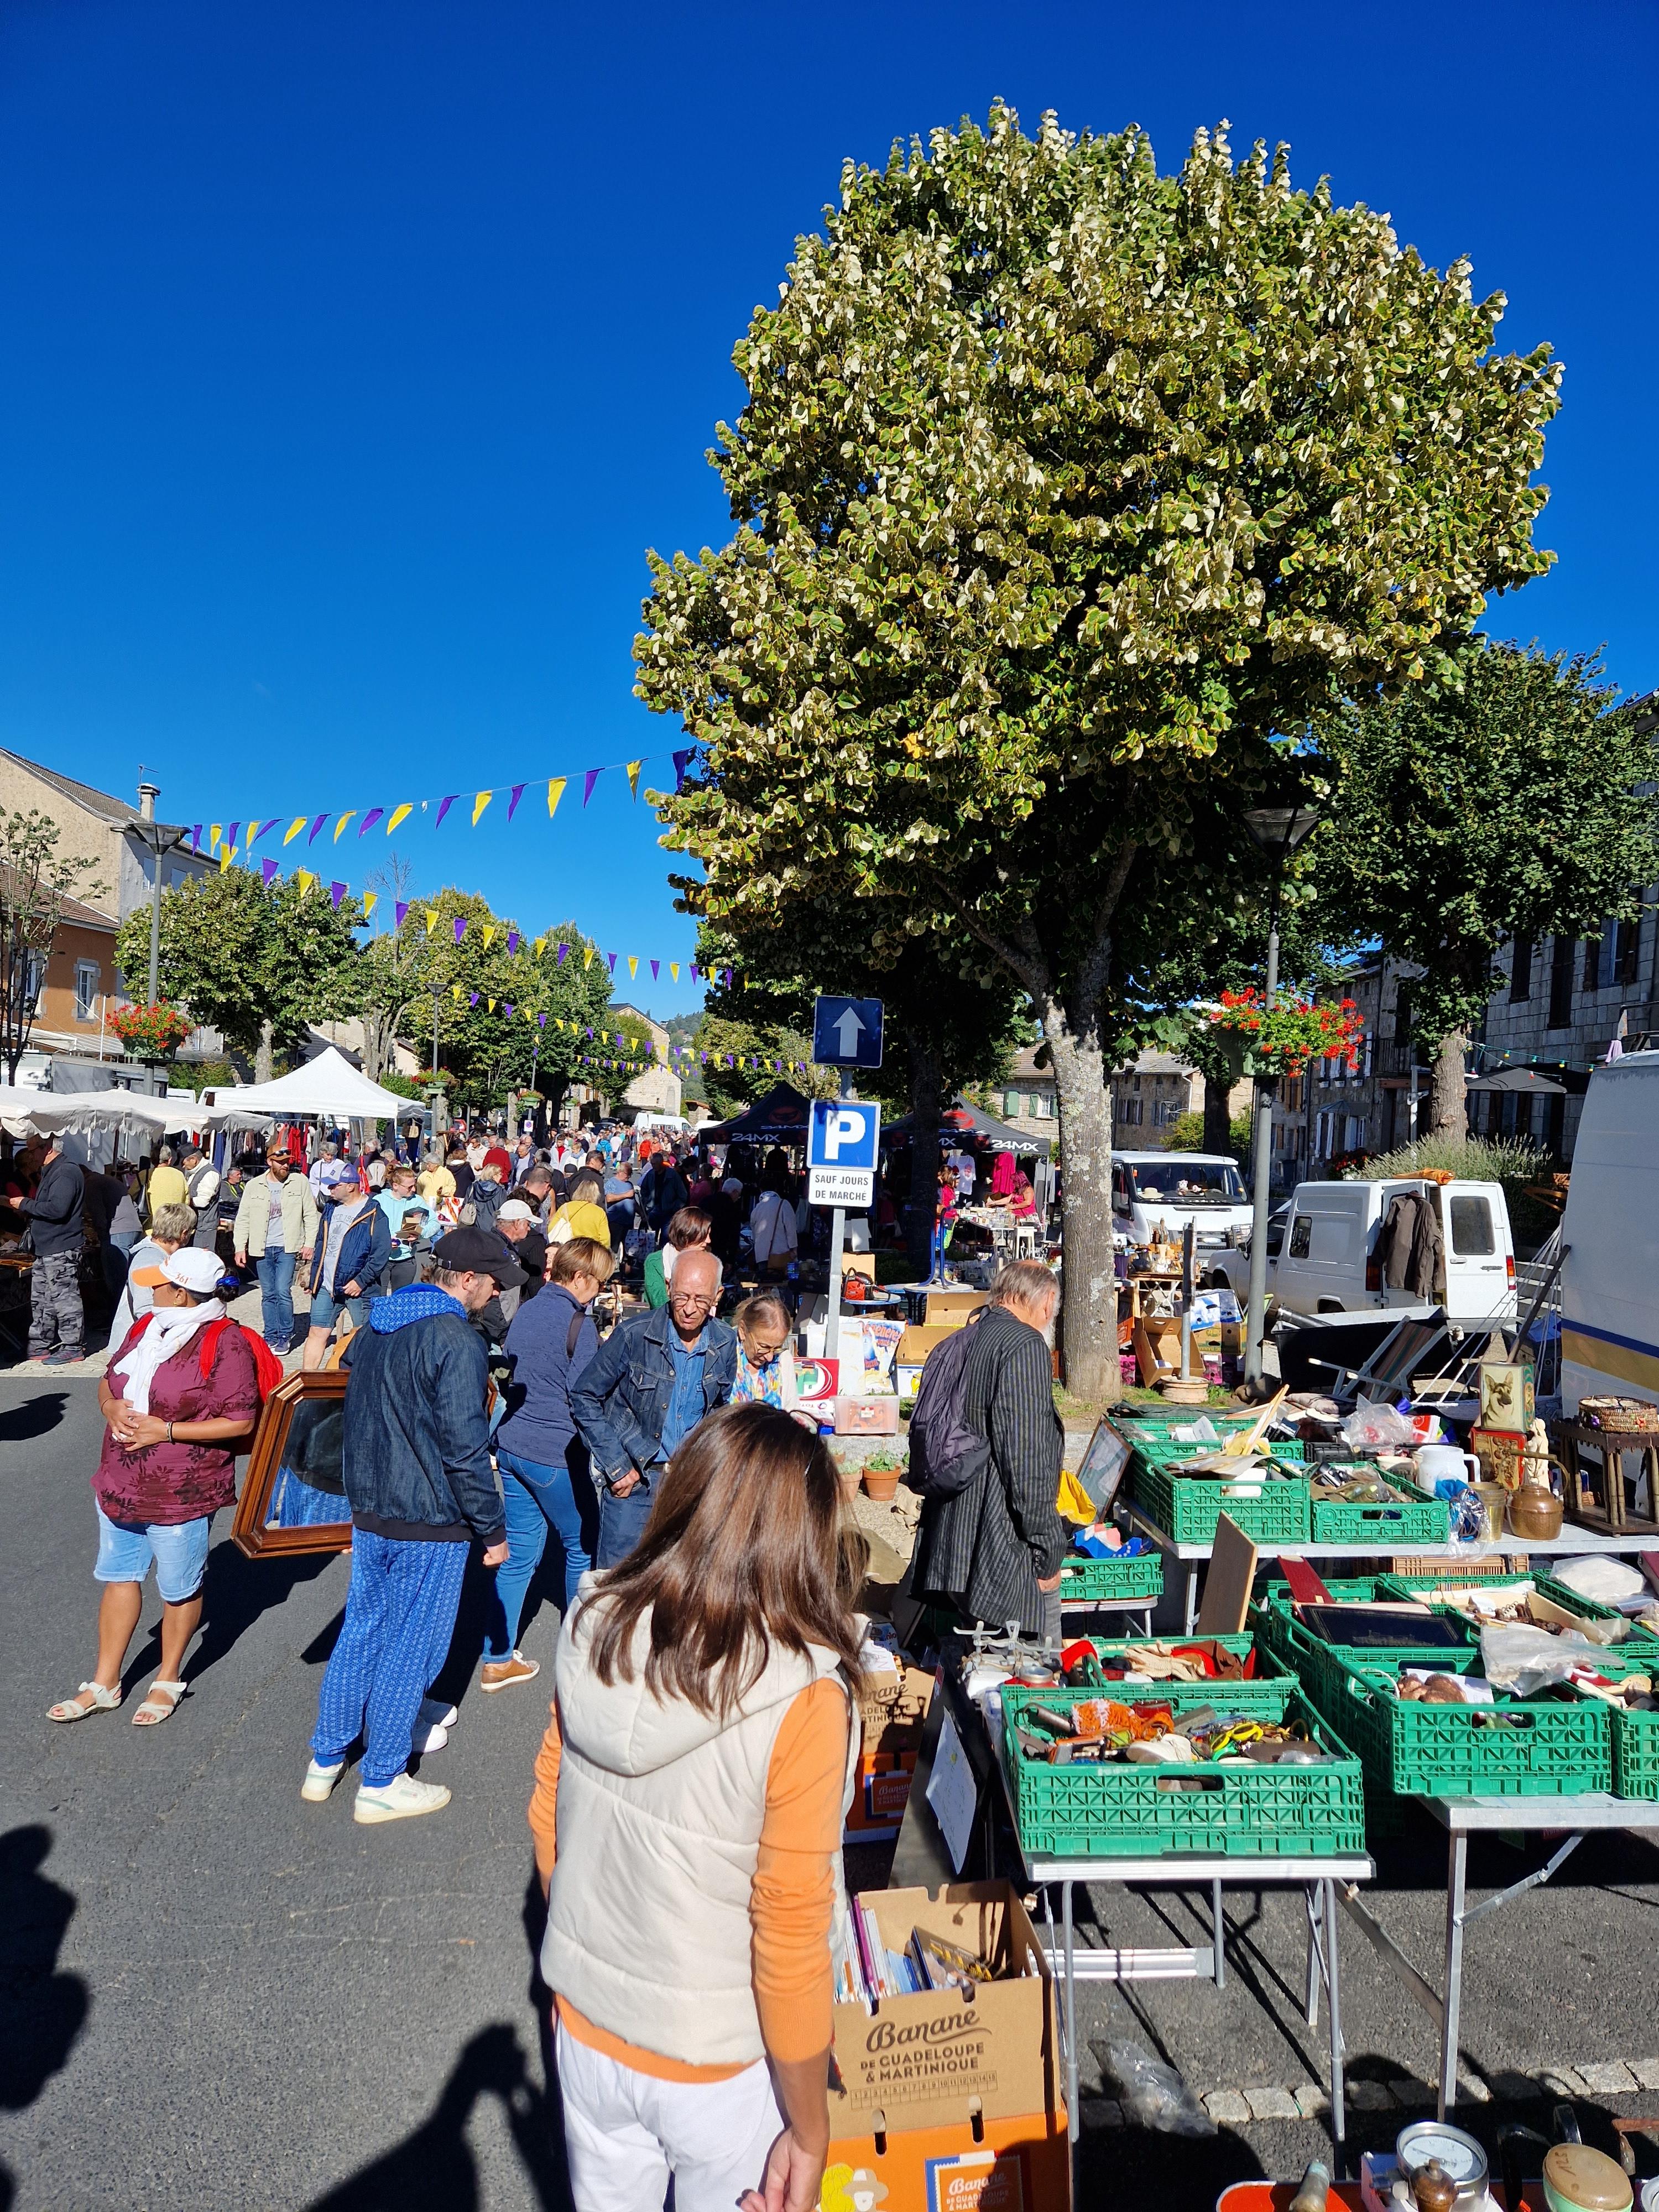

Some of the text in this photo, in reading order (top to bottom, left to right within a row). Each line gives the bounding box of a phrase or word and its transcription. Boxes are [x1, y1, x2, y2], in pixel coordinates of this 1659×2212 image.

[732, 1133, 780, 1142] 24MX
[825, 1110, 866, 1160] P
[992, 1139, 1039, 1152] 24MX
[815, 1175, 869, 1186] SAUF JOURS
[815, 1190, 826, 1198] DE
[867, 2009, 993, 2052] Banane
[860, 2042, 984, 2070] DE GUADELOUPE
[866, 2057, 979, 2083] & MARTINIQUE
